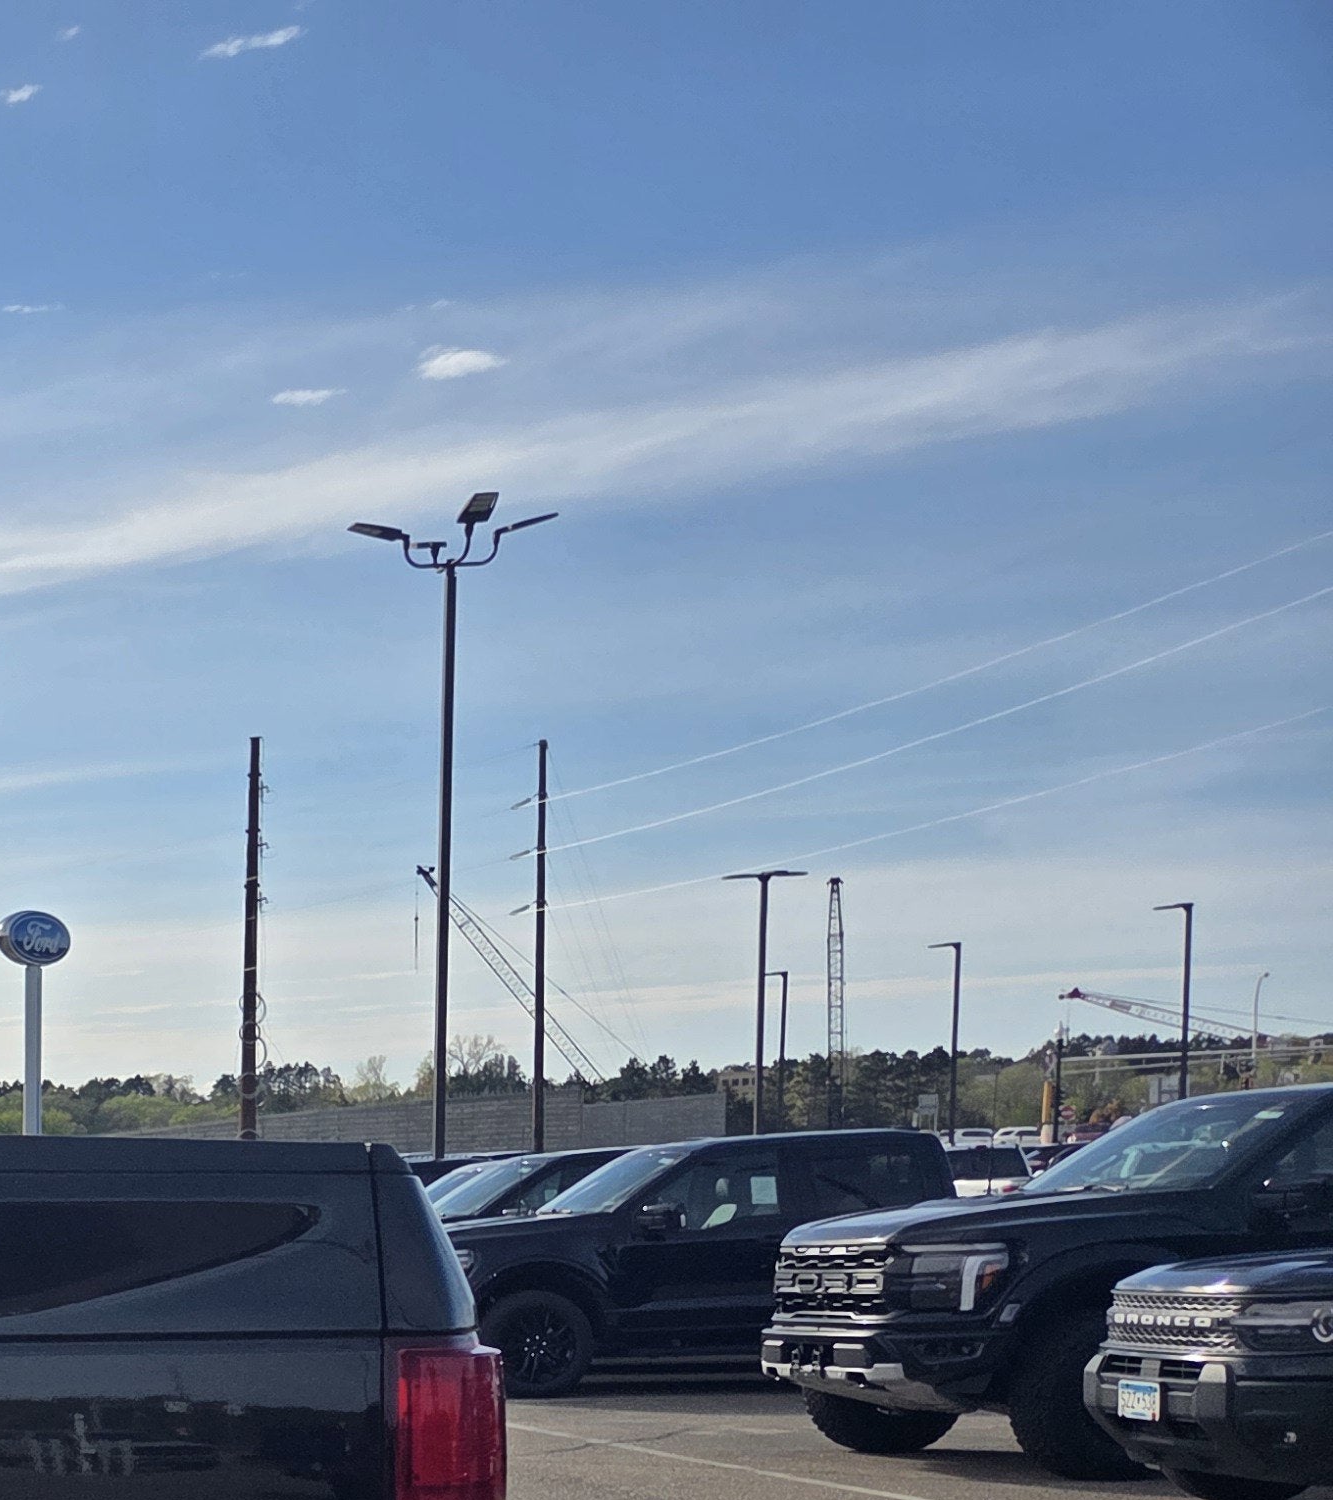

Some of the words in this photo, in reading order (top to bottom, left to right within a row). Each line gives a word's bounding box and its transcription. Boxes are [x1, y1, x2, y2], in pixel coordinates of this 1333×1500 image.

[22, 920, 61, 954] Ford
[774, 1272, 885, 1294] FORD
[1113, 1313, 1212, 1328] BRONCO
